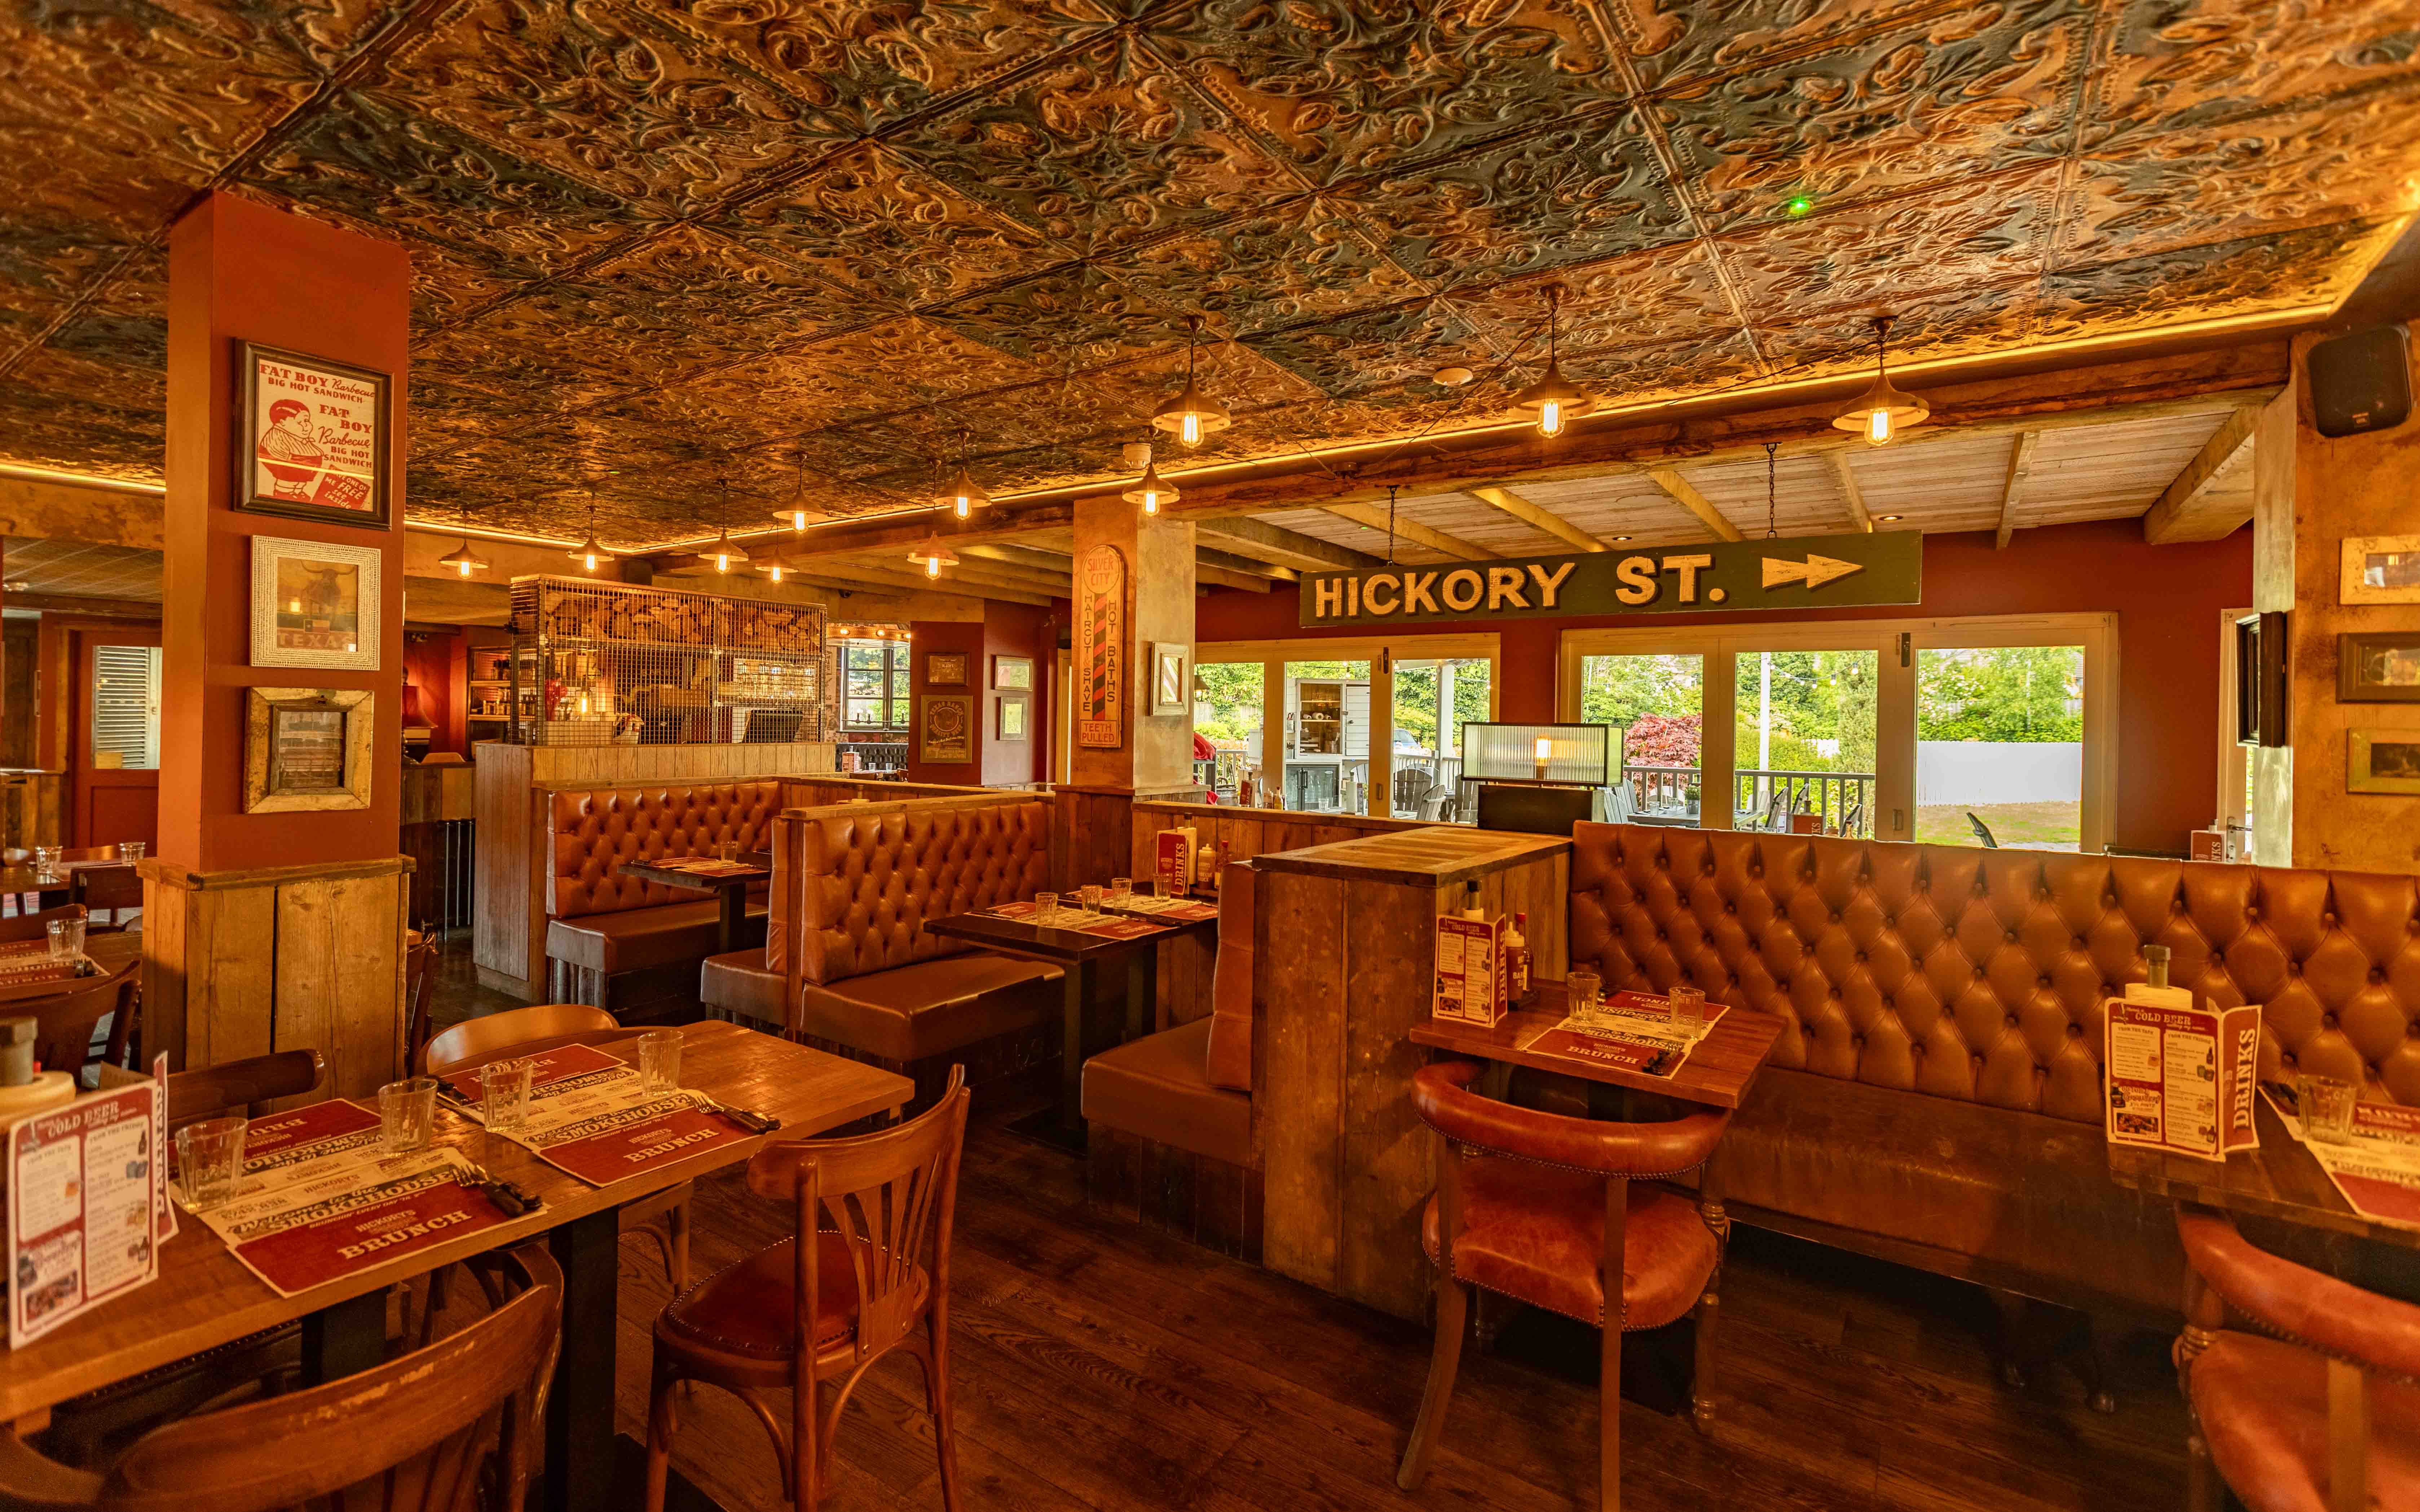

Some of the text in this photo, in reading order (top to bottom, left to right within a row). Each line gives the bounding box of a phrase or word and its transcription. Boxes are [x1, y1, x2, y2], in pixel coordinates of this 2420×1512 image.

[259, 364, 375, 398] FAT BOY Barbecue
[268, 377, 363, 403] BIG HOT SANDWICH
[319, 404, 349, 418] FAT
[318, 426, 370, 448] Barbecue
[340, 420, 372, 433] BOY
[324, 454, 372, 468] SANDWICH
[331, 446, 370, 459] BIG HOT
[325, 477, 364, 499] ME FREE
[346, 477, 359, 487] ONE
[325, 491, 352, 509] inside
[331, 490, 347, 499] see
[1088, 556, 1114, 571] SILVER
[1090, 572, 1110, 586] CITY
[1315, 554, 1726, 617] HICKORY ST.
[277, 632, 355, 650] TEXAS
[1107, 600, 1116, 702] HOT BATHS
[1083, 733, 1114, 742] PULLED
[1085, 723, 1111, 732] TEETH
[1175, 843, 1185, 887] DRINKS
[2135, 1012, 2191, 1025] COLD BEER
[1566, 1046, 1639, 1064] BRUNCH
[2234, 1029, 2256, 1129] DRINKS
[48, 1114, 81, 1138] COLD
[84, 1101, 119, 1124] BEER
[554, 1094, 690, 1141] SMOKEHOUSE!
[524, 1119, 592, 1142] Welcome
[623, 1129, 719, 1162] BRUNCH
[227, 1186, 378, 1234] Welcome to the
[309, 1212, 354, 1229] BRUNCHIN'
[356, 1204, 381, 1215] EVERY
[383, 1199, 398, 1208] DAY
[355, 1209, 416, 1232] HICKORY'S
[338, 1210, 472, 1259] BRUNCH
